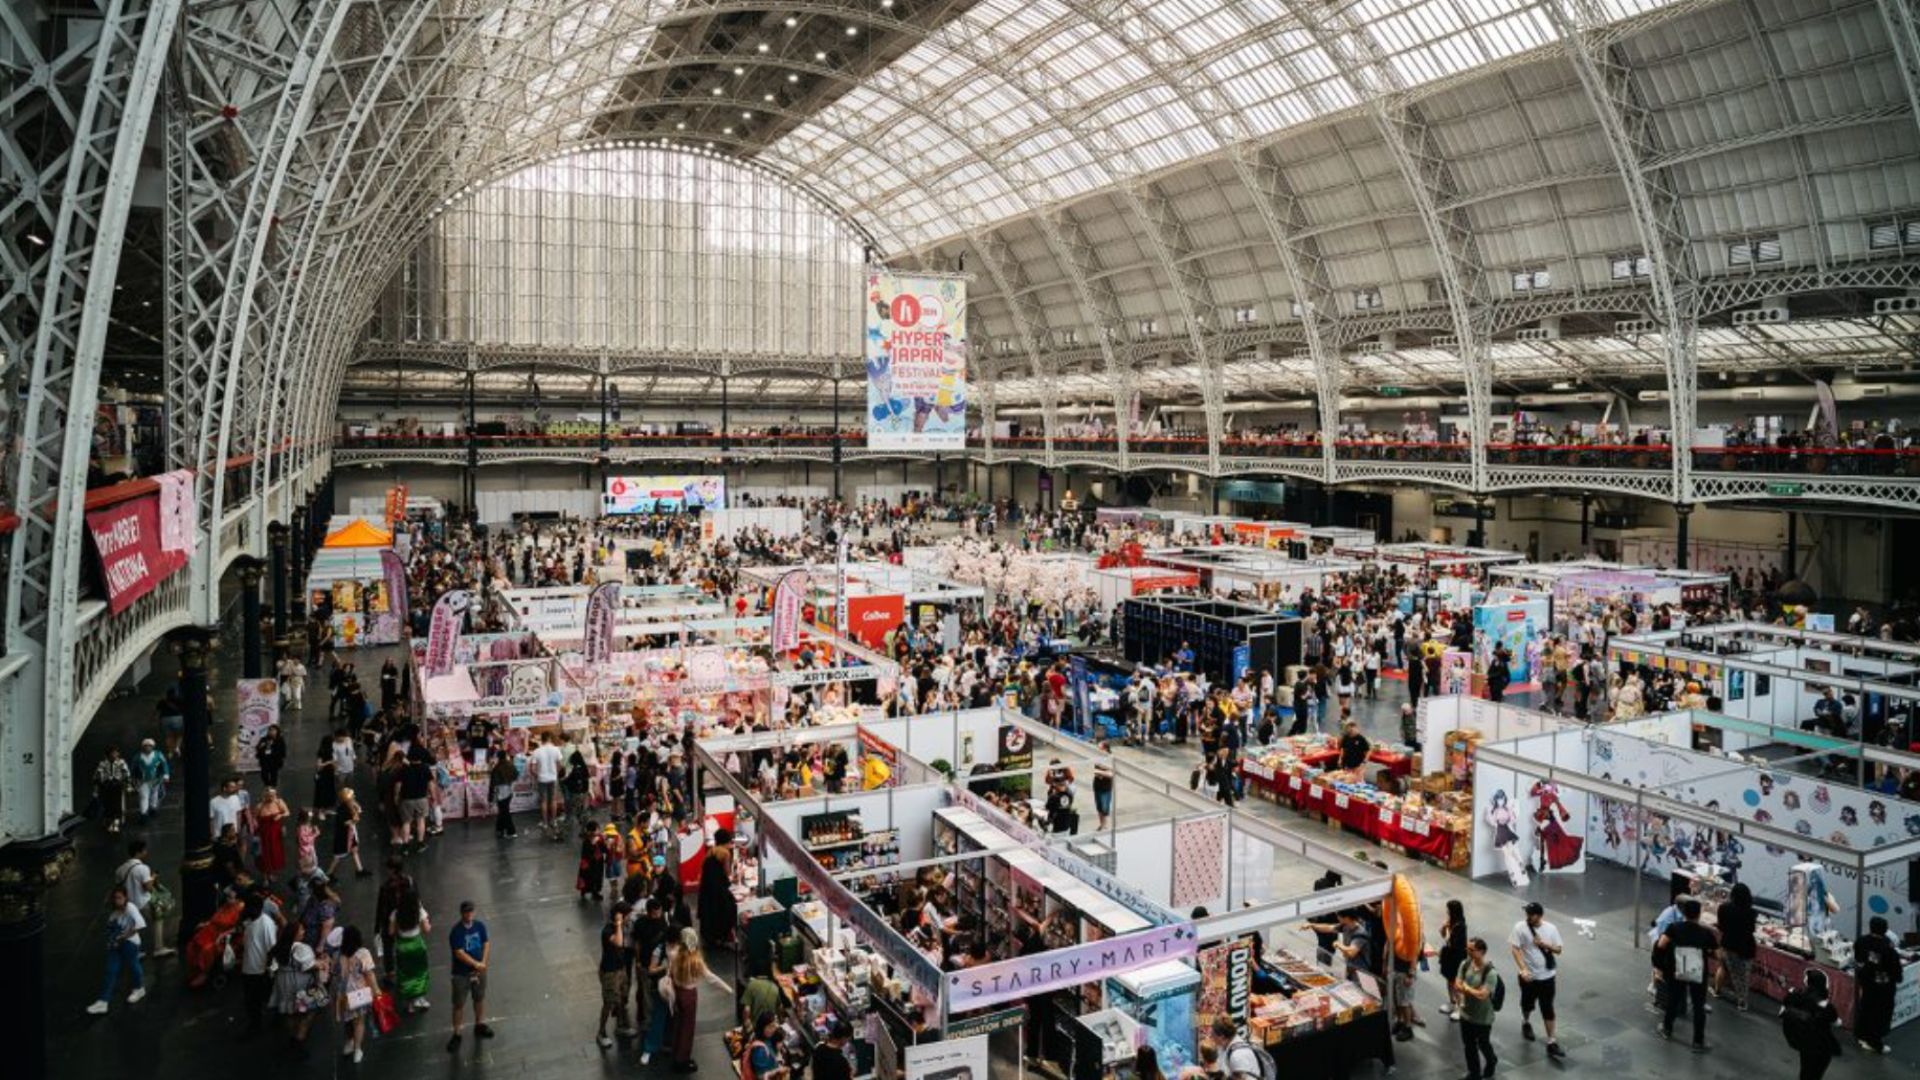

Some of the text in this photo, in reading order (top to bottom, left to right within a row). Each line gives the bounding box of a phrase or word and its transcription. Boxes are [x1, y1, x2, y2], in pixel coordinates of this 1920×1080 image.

[891, 330, 944, 347] HYPER
[891, 349, 944, 365] JAPAN
[892, 366, 942, 378] FESTIVAL
[862, 610, 892, 621] Calbee
[22, 752, 35, 765] 2
[970, 937, 1172, 998] STARRY MART
